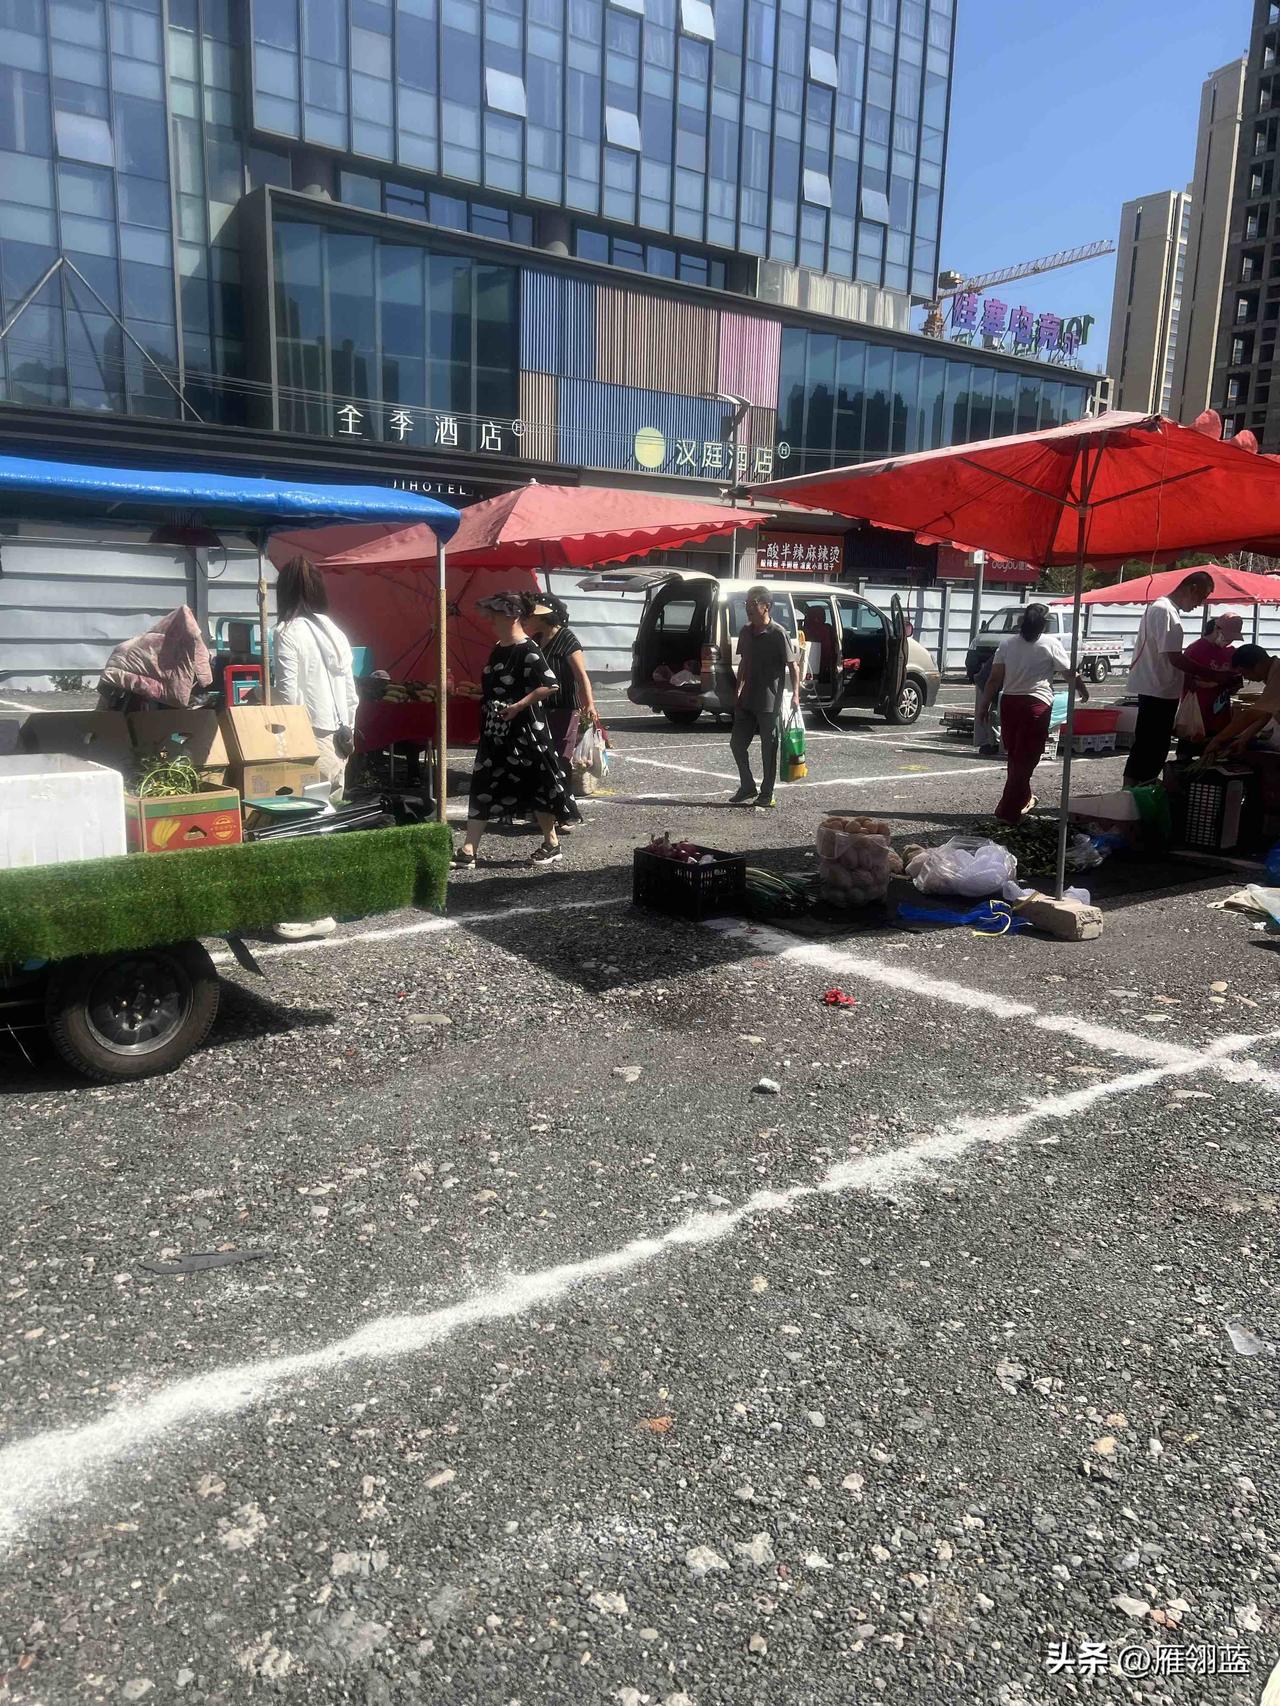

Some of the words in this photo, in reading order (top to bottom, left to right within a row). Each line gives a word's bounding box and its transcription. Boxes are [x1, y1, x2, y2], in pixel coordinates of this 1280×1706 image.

[336, 404, 502, 451] 全季酒店
[676, 439, 773, 474] 汉庭酒店
[757, 542, 840, 563] 一酸半辣麻辣烫
